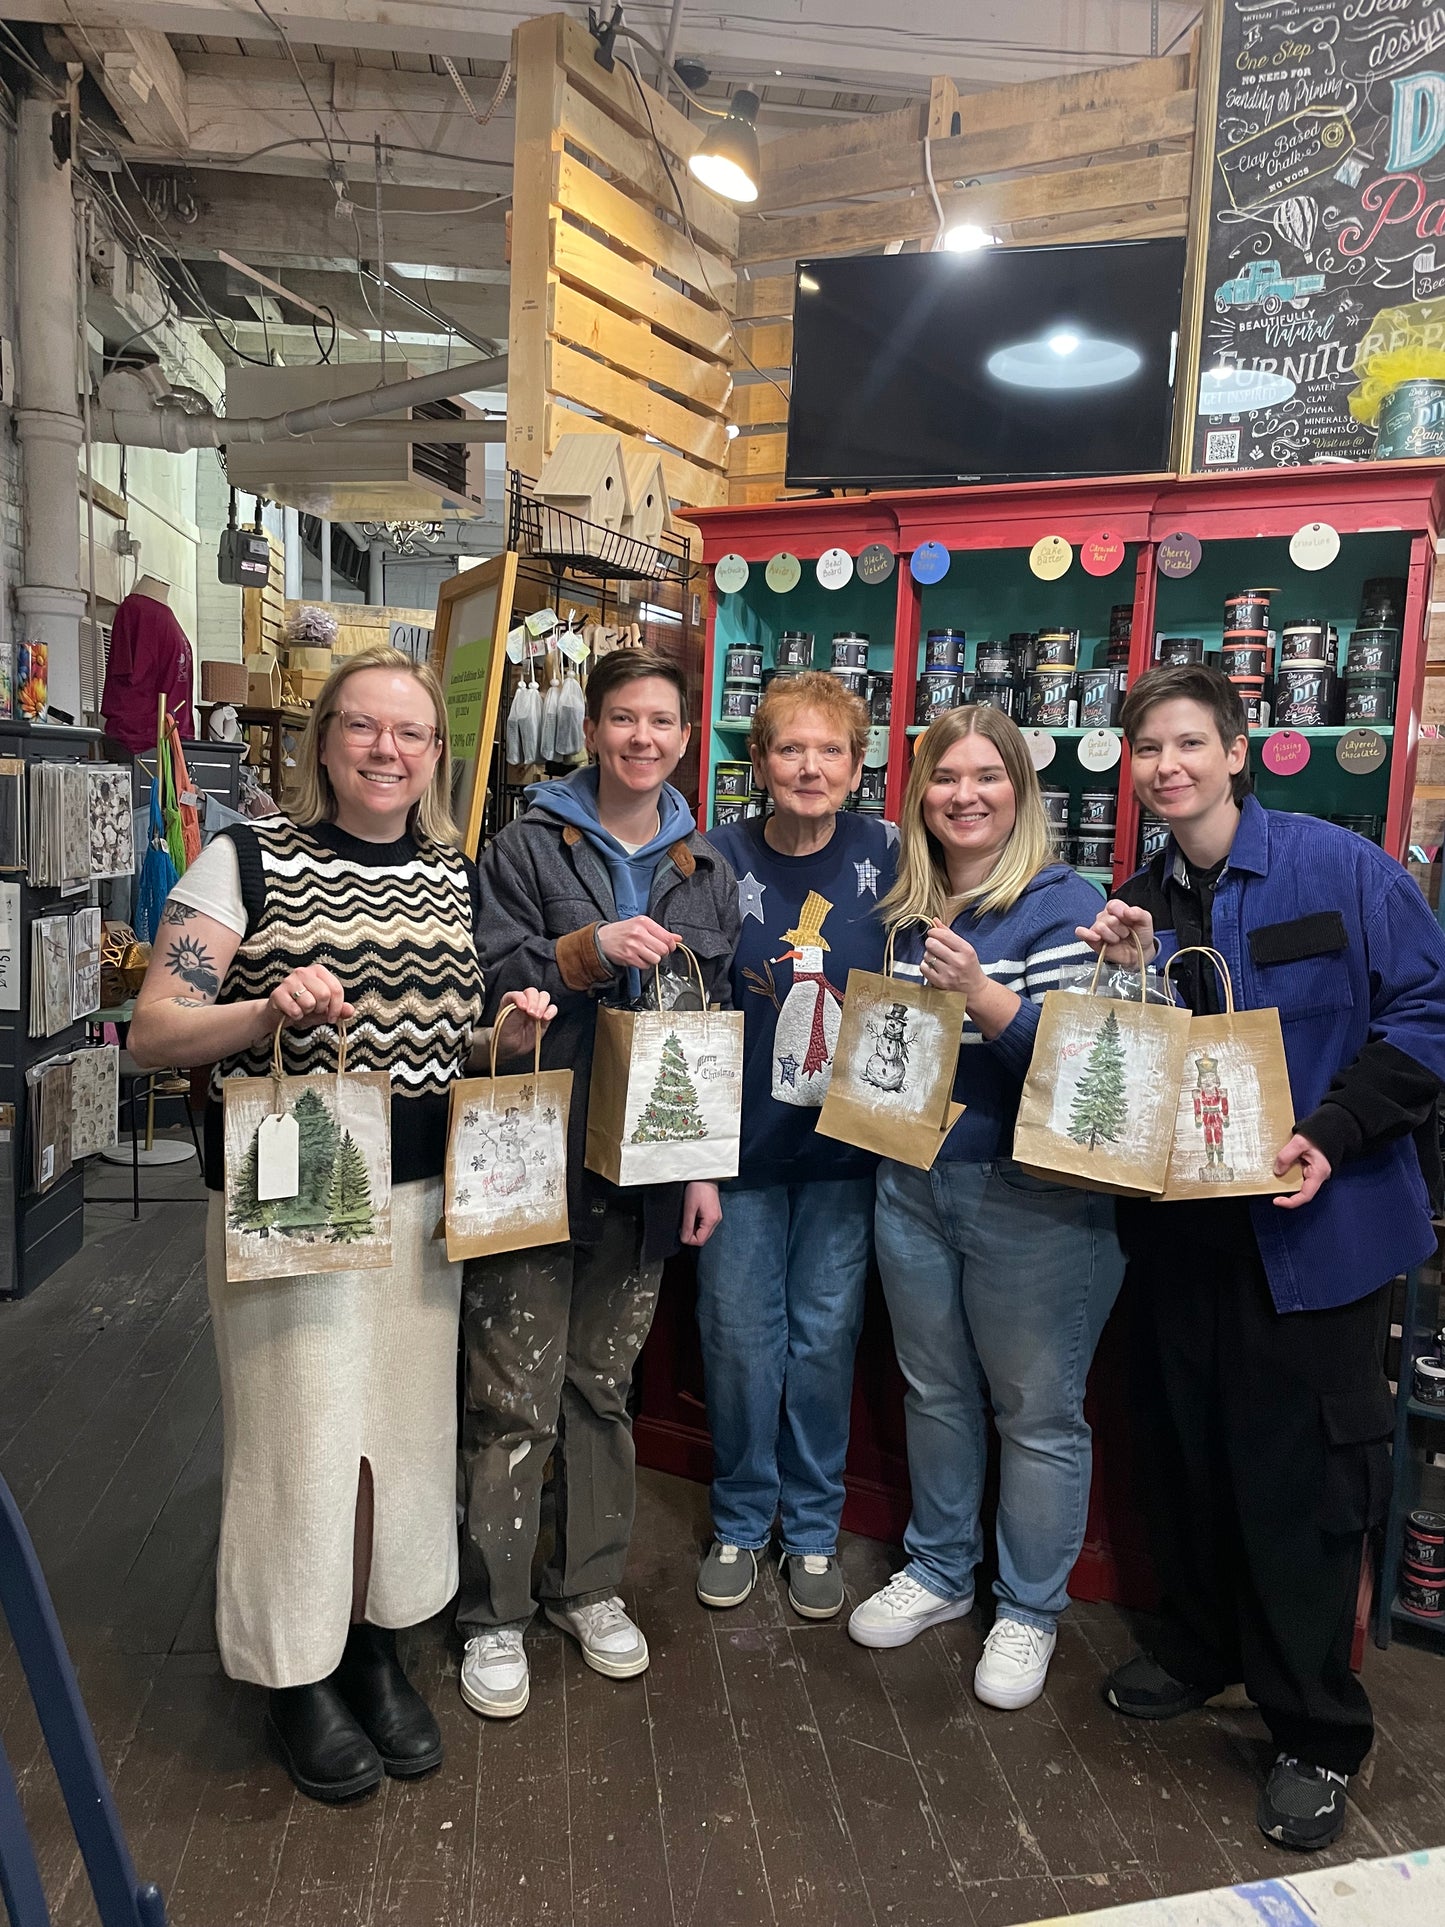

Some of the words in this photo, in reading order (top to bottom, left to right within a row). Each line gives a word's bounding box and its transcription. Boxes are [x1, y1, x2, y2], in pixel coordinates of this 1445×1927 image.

[1369, 8, 1445, 67] design
[1236, 51, 1269, 70] One
[1272, 40, 1314, 65] Step
[1241, 74, 1256, 86] NO
[1258, 71, 1288, 84] NEED
[1290, 67, 1312, 79] FOR
[1225, 83, 1275, 126] Sanding
[1277, 88, 1293, 112] or
[1294, 78, 1344, 112] Priming
[1237, 151, 1270, 173] Clay
[1272, 121, 1321, 158] Based
[1266, 150, 1307, 176] Chalk
[1268, 181, 1283, 193] NO
[1239, 309, 1317, 332] BEAUTIFULLY
[1265, 313, 1336, 348] Natural
[1307, 383, 1336, 392] WATER
[1306, 396, 1328, 404] CLAY
[1305, 406, 1335, 414] CHALK
[1304, 416, 1348, 425] MINERALS
[1303, 426, 1346, 436] PIGMENTS
[1313, 436, 1338, 449] Visit
[1040, 547, 1062, 556] Cake
[1160, 545, 1191, 562] Cherry
[824, 557, 842, 568] Bead
[1036, 554, 1065, 566] Batter
[1164, 559, 1192, 570] Picked
[823, 567, 842, 578] Board
[863, 560, 888, 576] Velvet
[932, 684, 955, 704] DIY
[1044, 683, 1069, 704] DIY
[1084, 684, 1109, 704] DIY
[1293, 680, 1322, 703] DIY
[1040, 704, 1066, 715] Paint
[1288, 702, 1319, 716] Paint
[1088, 738, 1113, 749] Gravel
[1273, 743, 1301, 754] Kissing
[1345, 738, 1377, 750] Layered
[1088, 748, 1110, 758] Road
[1275, 752, 1297, 762] Booth
[1341, 749, 1381, 760] Chocolate
[725, 780, 738, 790] DIY
[1091, 805, 1105, 818] DIY
[1144, 832, 1169, 853] DIY
[1084, 843, 1098, 856] DIY
[694, 1055, 717, 1074] Merry
[701, 1067, 735, 1082] Christmas
[1420, 1550, 1436, 1559] DIY
[1426, 1592, 1440, 1606] DIY
